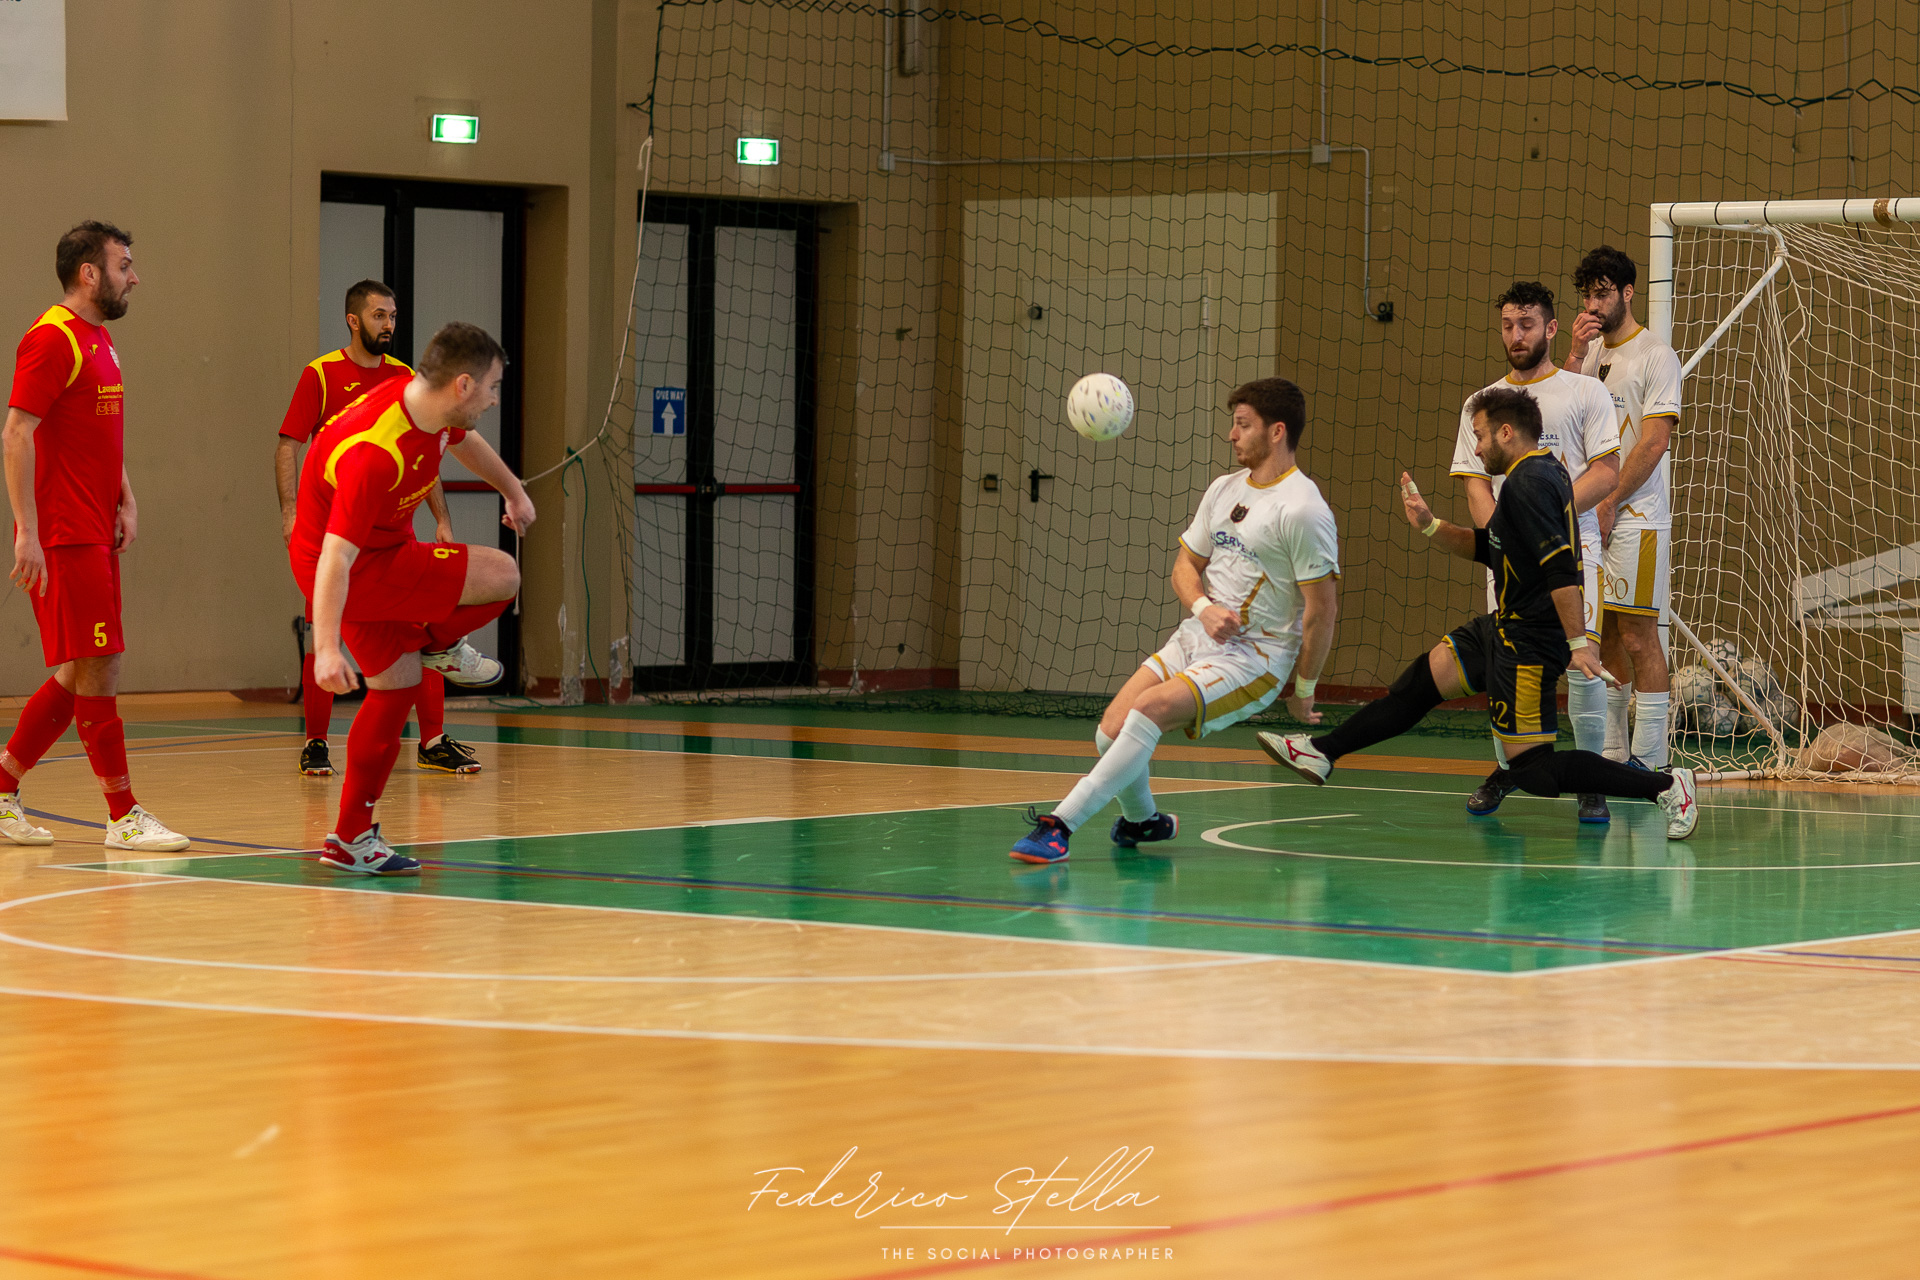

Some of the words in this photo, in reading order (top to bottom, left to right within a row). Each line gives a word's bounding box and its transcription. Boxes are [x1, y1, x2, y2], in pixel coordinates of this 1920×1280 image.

[656, 390, 669, 400] ONE
[670, 391, 684, 400] WAY
[1603, 573, 1629, 600] 80
[94, 622, 107, 647] 5
